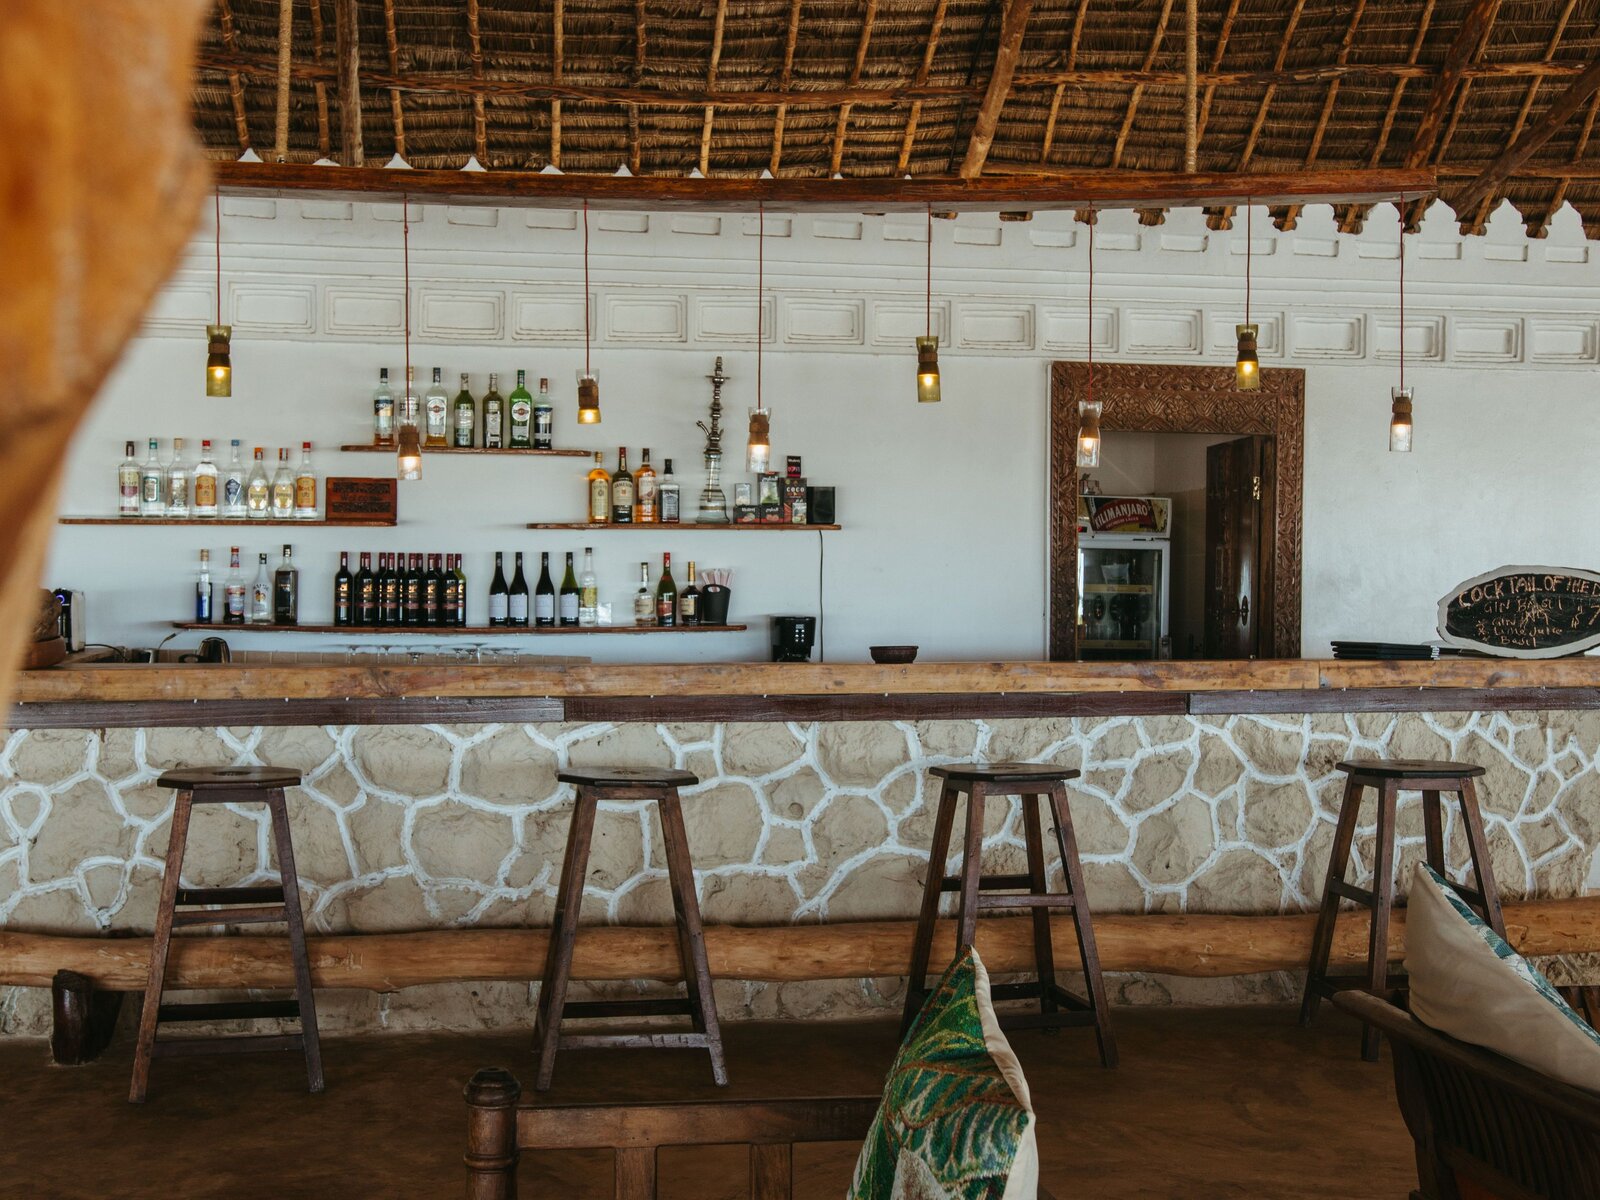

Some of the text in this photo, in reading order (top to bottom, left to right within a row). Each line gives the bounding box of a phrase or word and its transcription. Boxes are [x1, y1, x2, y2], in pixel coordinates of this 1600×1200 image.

[1095, 503, 1148, 529] KILIMANJARO
[1544, 575, 1564, 592] OF
[1566, 576, 1590, 593] THE
[1484, 599, 1510, 614] GIN
